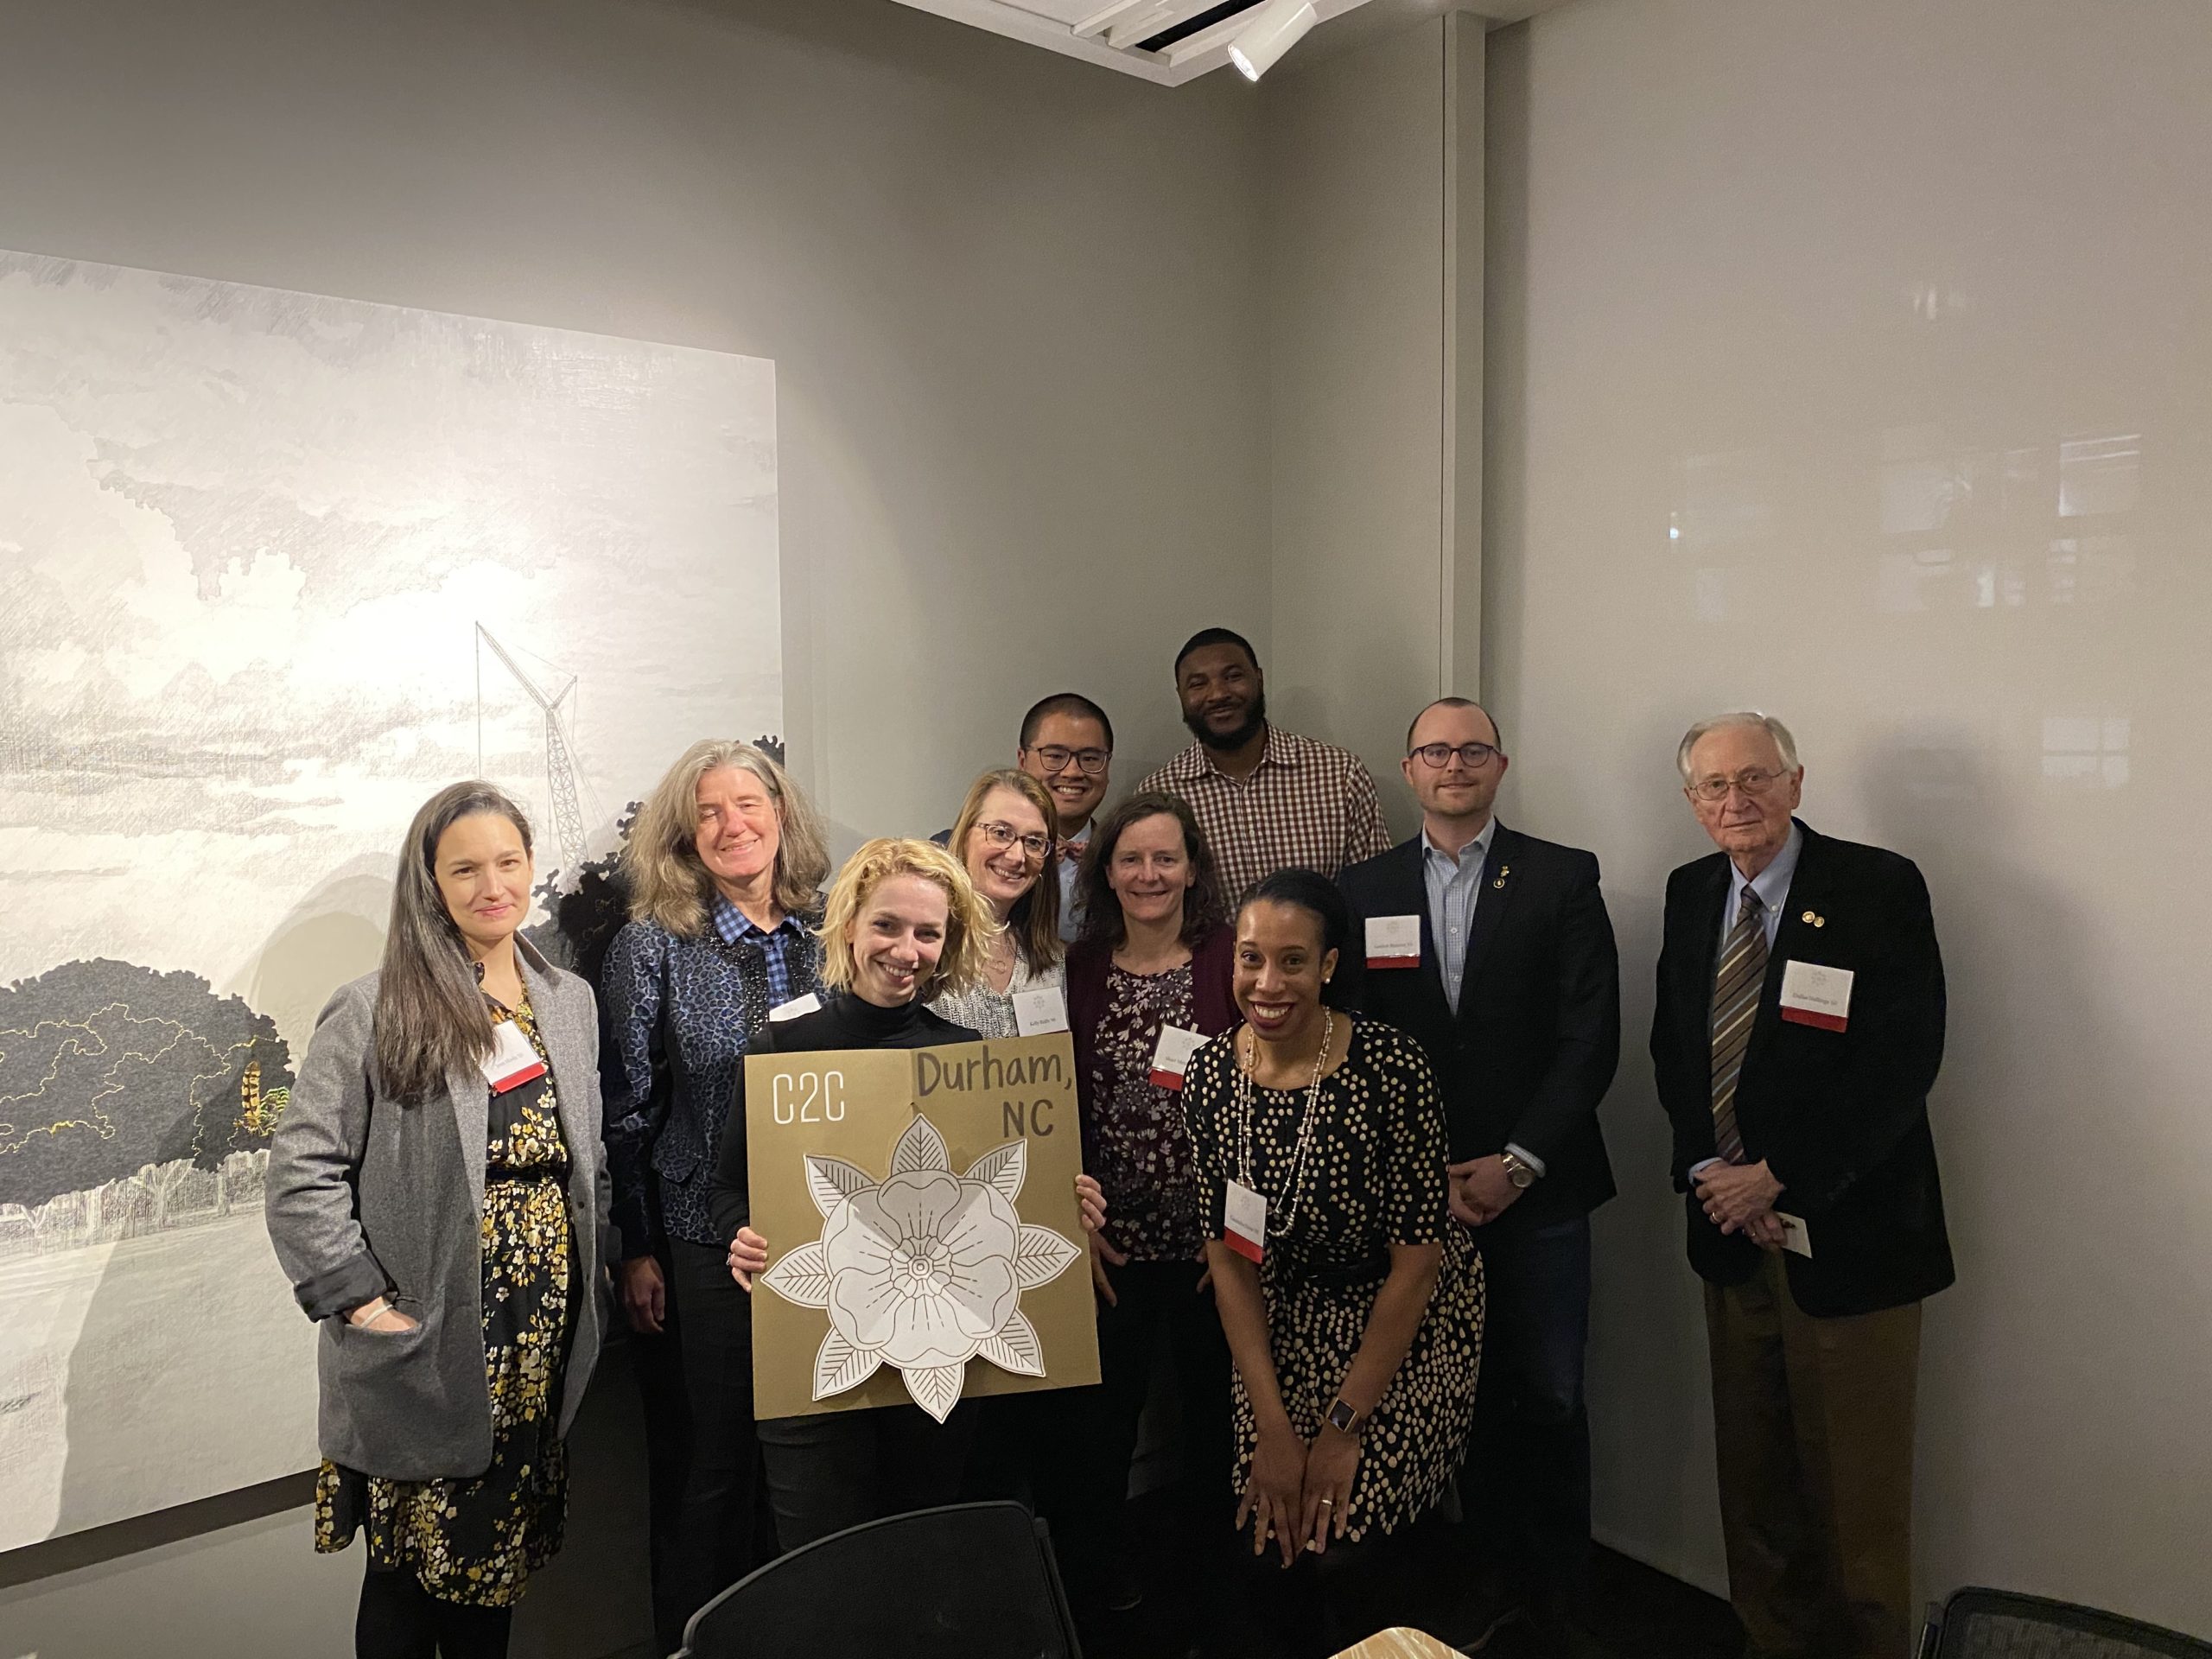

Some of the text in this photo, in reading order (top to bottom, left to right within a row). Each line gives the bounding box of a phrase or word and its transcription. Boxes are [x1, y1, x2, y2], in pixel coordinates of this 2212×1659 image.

[917, 1045, 1072, 1097] Durham,
[772, 1071, 846, 1125] C2C
[1002, 1099, 1054, 1138] NC
